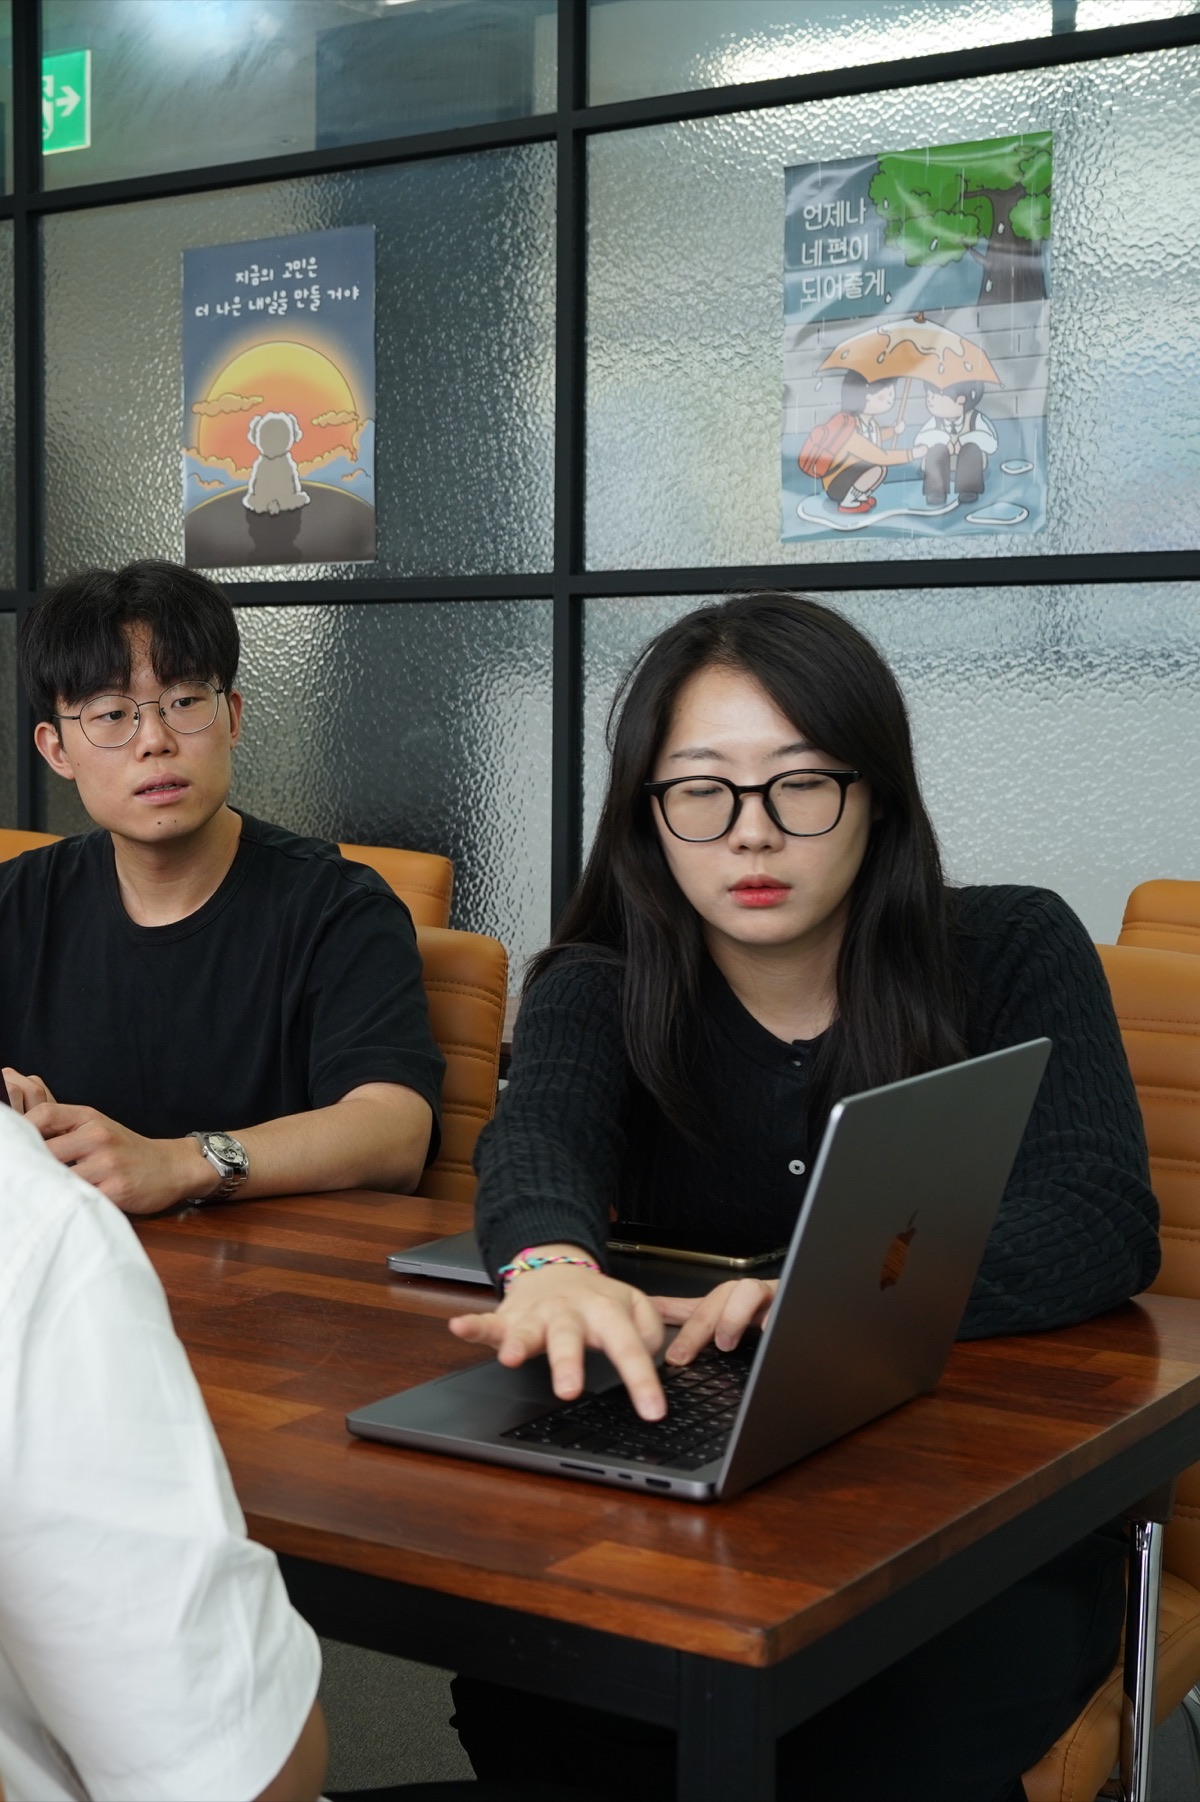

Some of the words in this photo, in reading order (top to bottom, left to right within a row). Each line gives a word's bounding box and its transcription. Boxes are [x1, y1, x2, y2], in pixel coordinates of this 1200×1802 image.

[803, 197, 867, 231] 언제나
[801, 239, 823, 267] 네
[827, 233, 869, 264] 편이
[235, 264, 274, 286] 지금의
[282, 256, 319, 279] 고민은
[800, 268, 886, 304] 되어줄게
[195, 303, 209, 317] 더
[216, 296, 242, 317] 나은
[248, 290, 289, 316] 내일을
[293, 285, 322, 312] 만들
[326, 285, 360, 301] 거야
